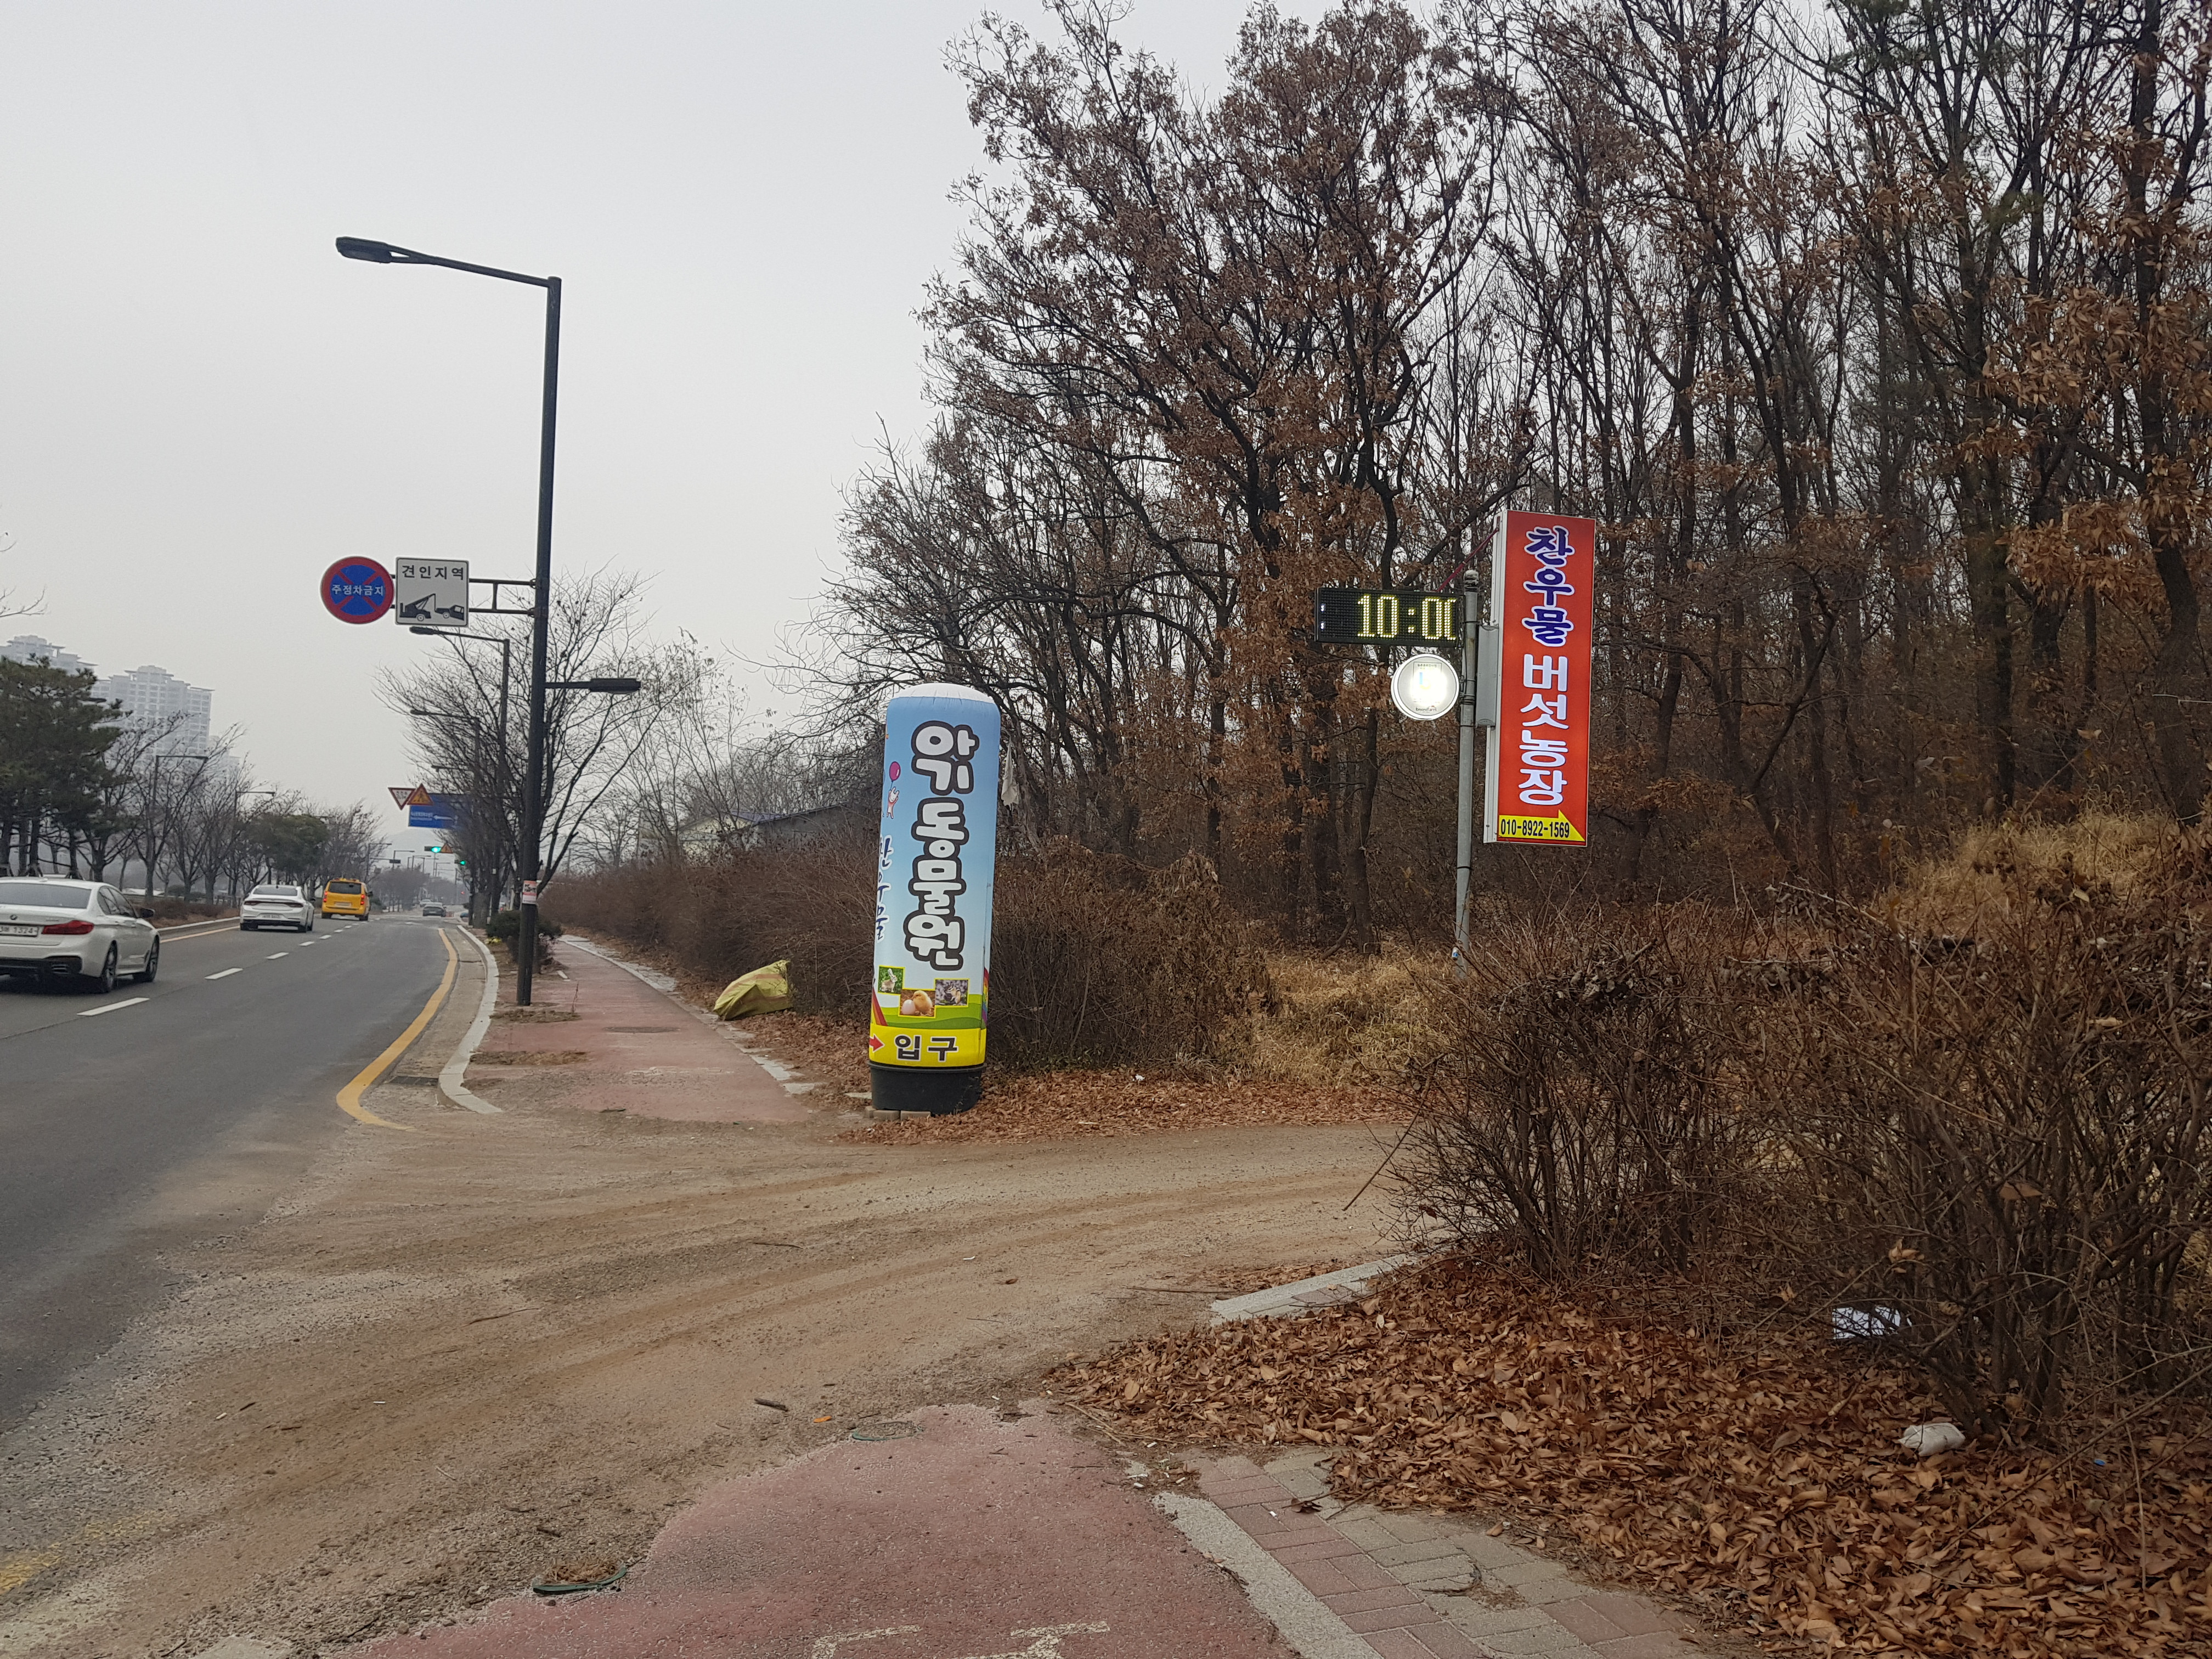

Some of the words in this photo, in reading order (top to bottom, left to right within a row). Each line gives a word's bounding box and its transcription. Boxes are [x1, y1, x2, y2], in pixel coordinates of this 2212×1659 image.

[402, 565, 464, 580] 견인지역
[331, 584, 384, 596] 주정차금지
[1522, 526, 1575, 647] 찬우물
[1519, 653, 1569, 805] 버섯농장
[1500, 819, 1570, 838] 010-8922-1569
[894, 1034, 959, 1063] 입구
